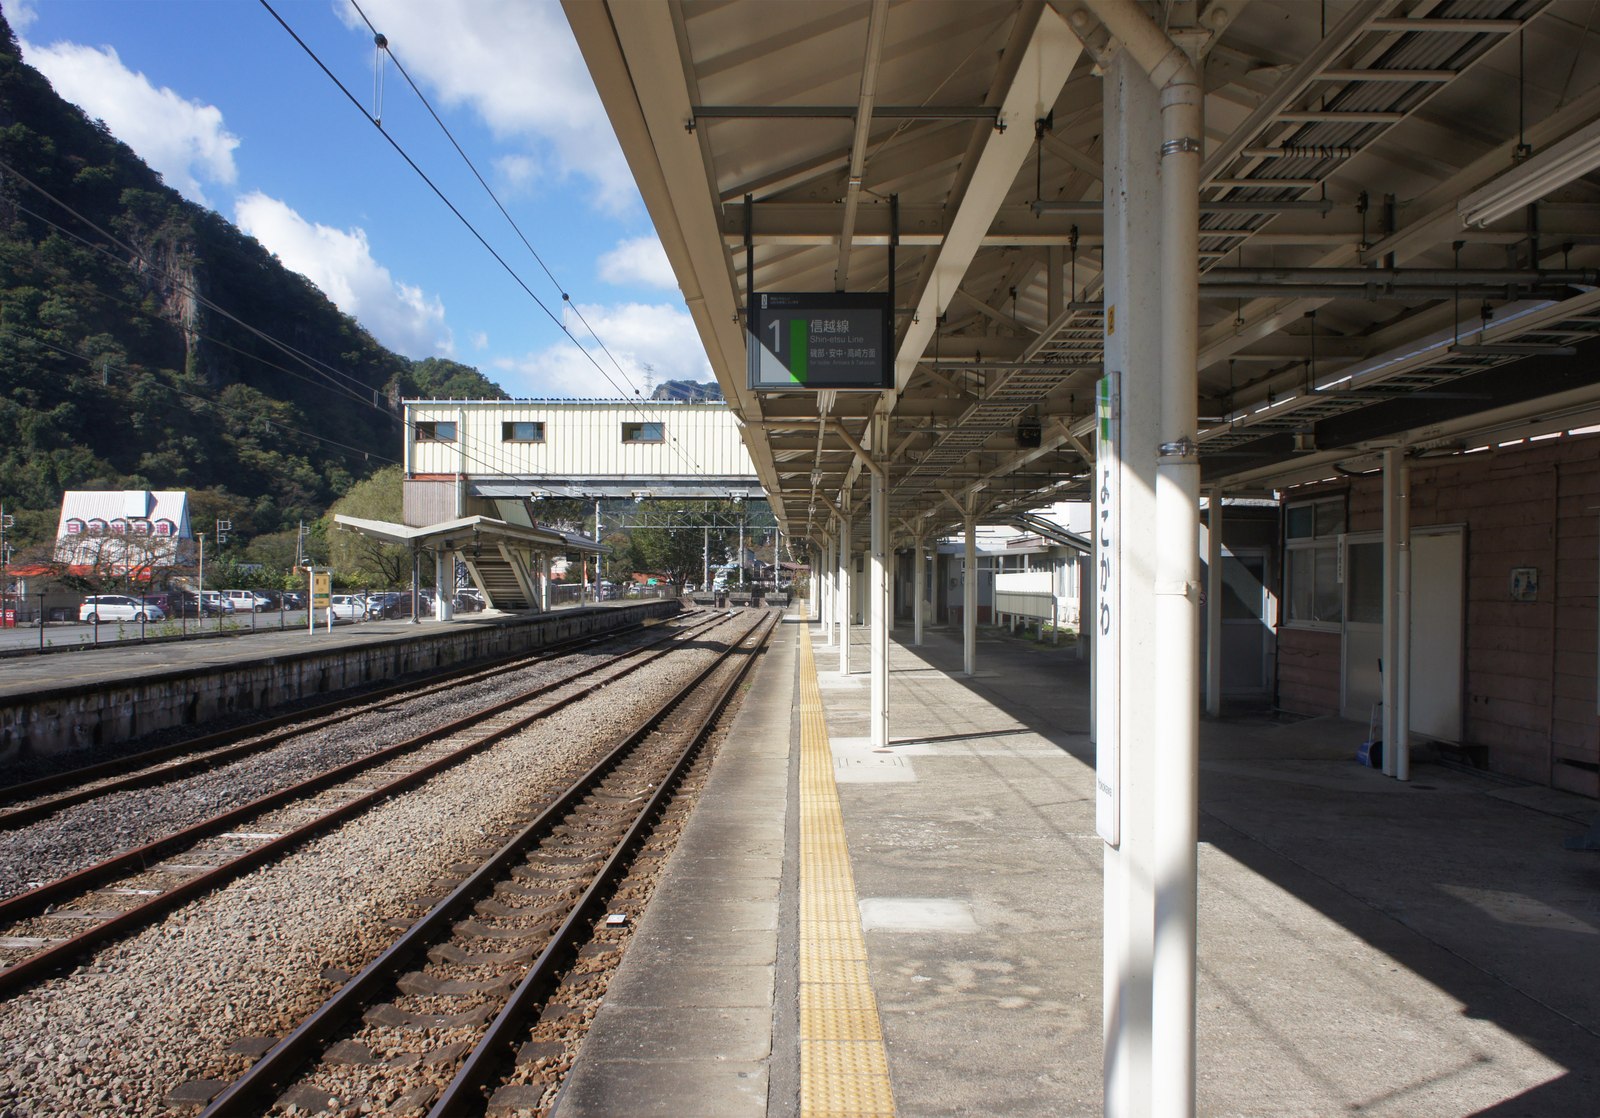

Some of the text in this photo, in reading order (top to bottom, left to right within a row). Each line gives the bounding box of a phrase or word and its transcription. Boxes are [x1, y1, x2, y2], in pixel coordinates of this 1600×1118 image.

[768, 319, 780, 353] 1
[810, 319, 849, 333] 信越線
[847, 335, 864, 343] Line
[1100, 464, 1111, 636] よこかわ
